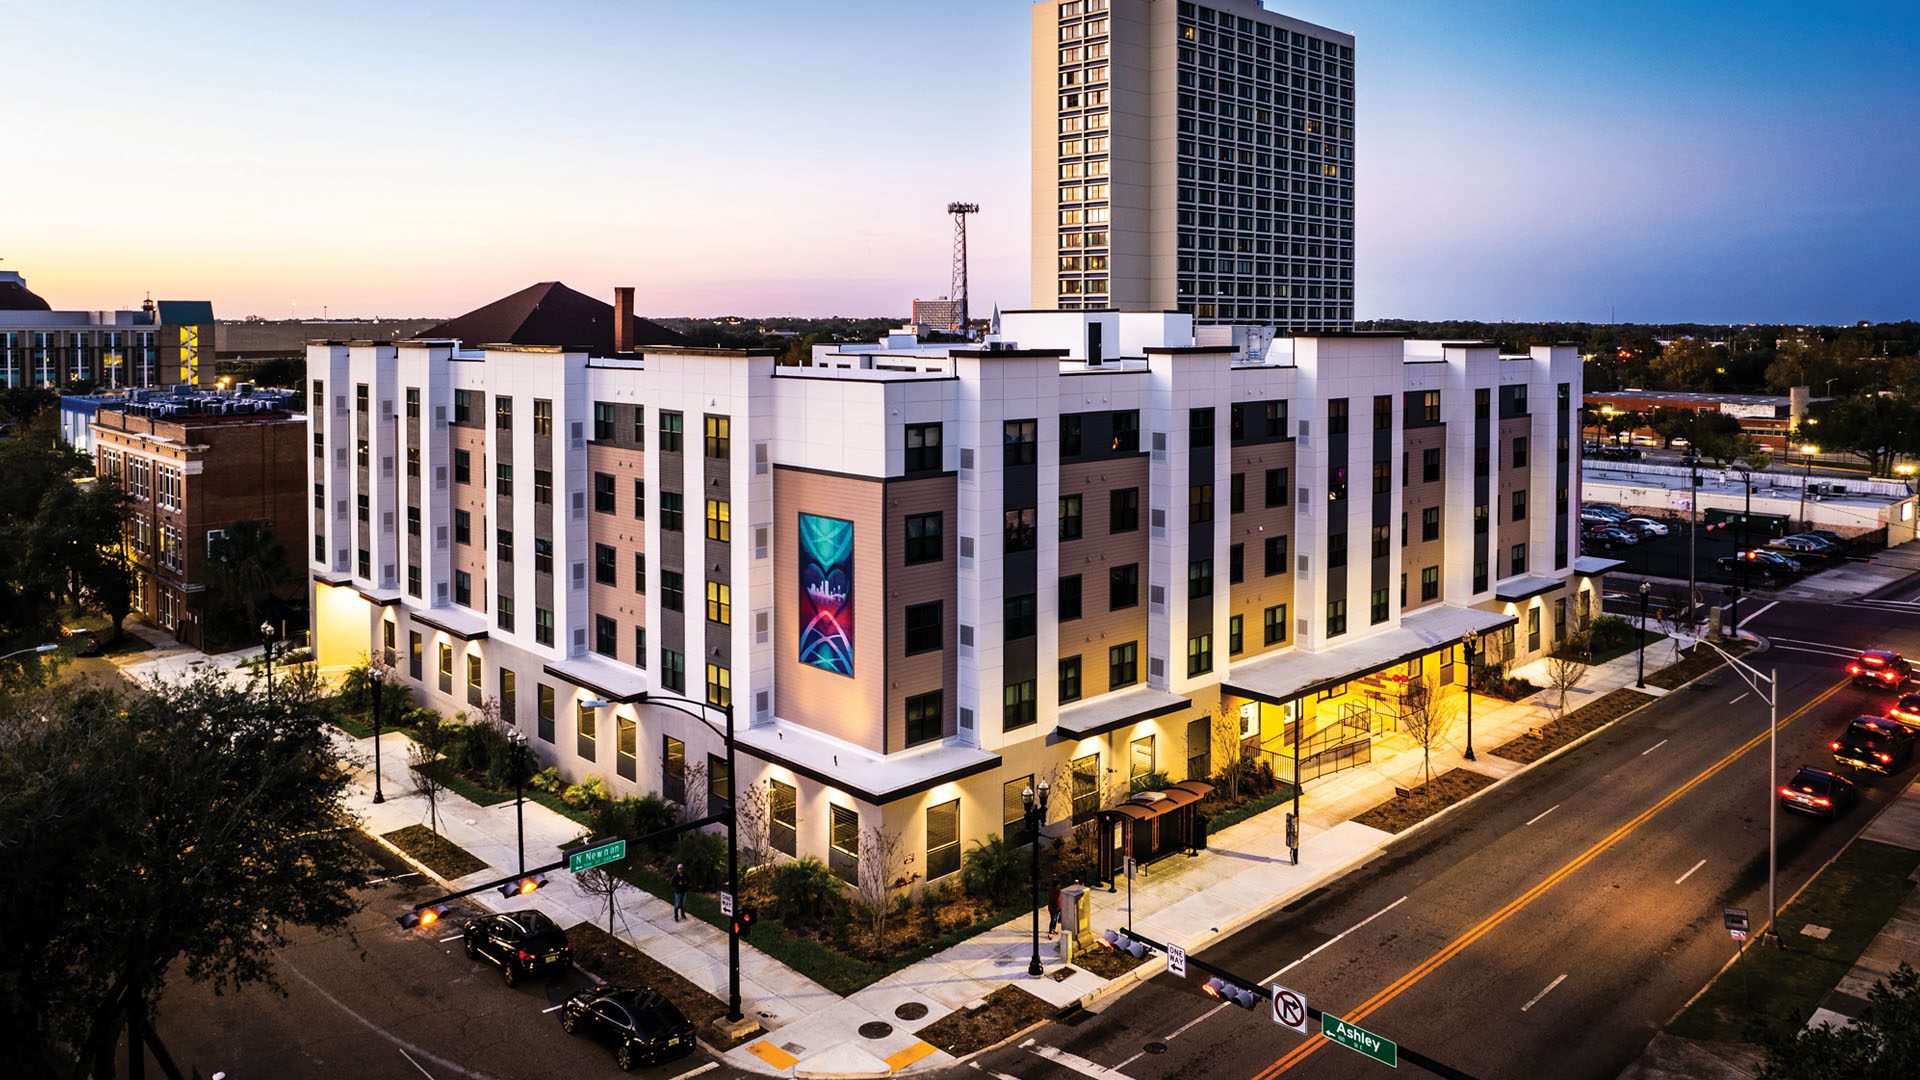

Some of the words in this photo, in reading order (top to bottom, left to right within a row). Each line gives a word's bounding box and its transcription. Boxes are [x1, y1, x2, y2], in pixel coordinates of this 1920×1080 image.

[576, 853, 582, 865] N
[1169, 946, 1184, 958] ONE
[1169, 954, 1184, 966] WAY
[1336, 1022, 1381, 1052] Ashley
